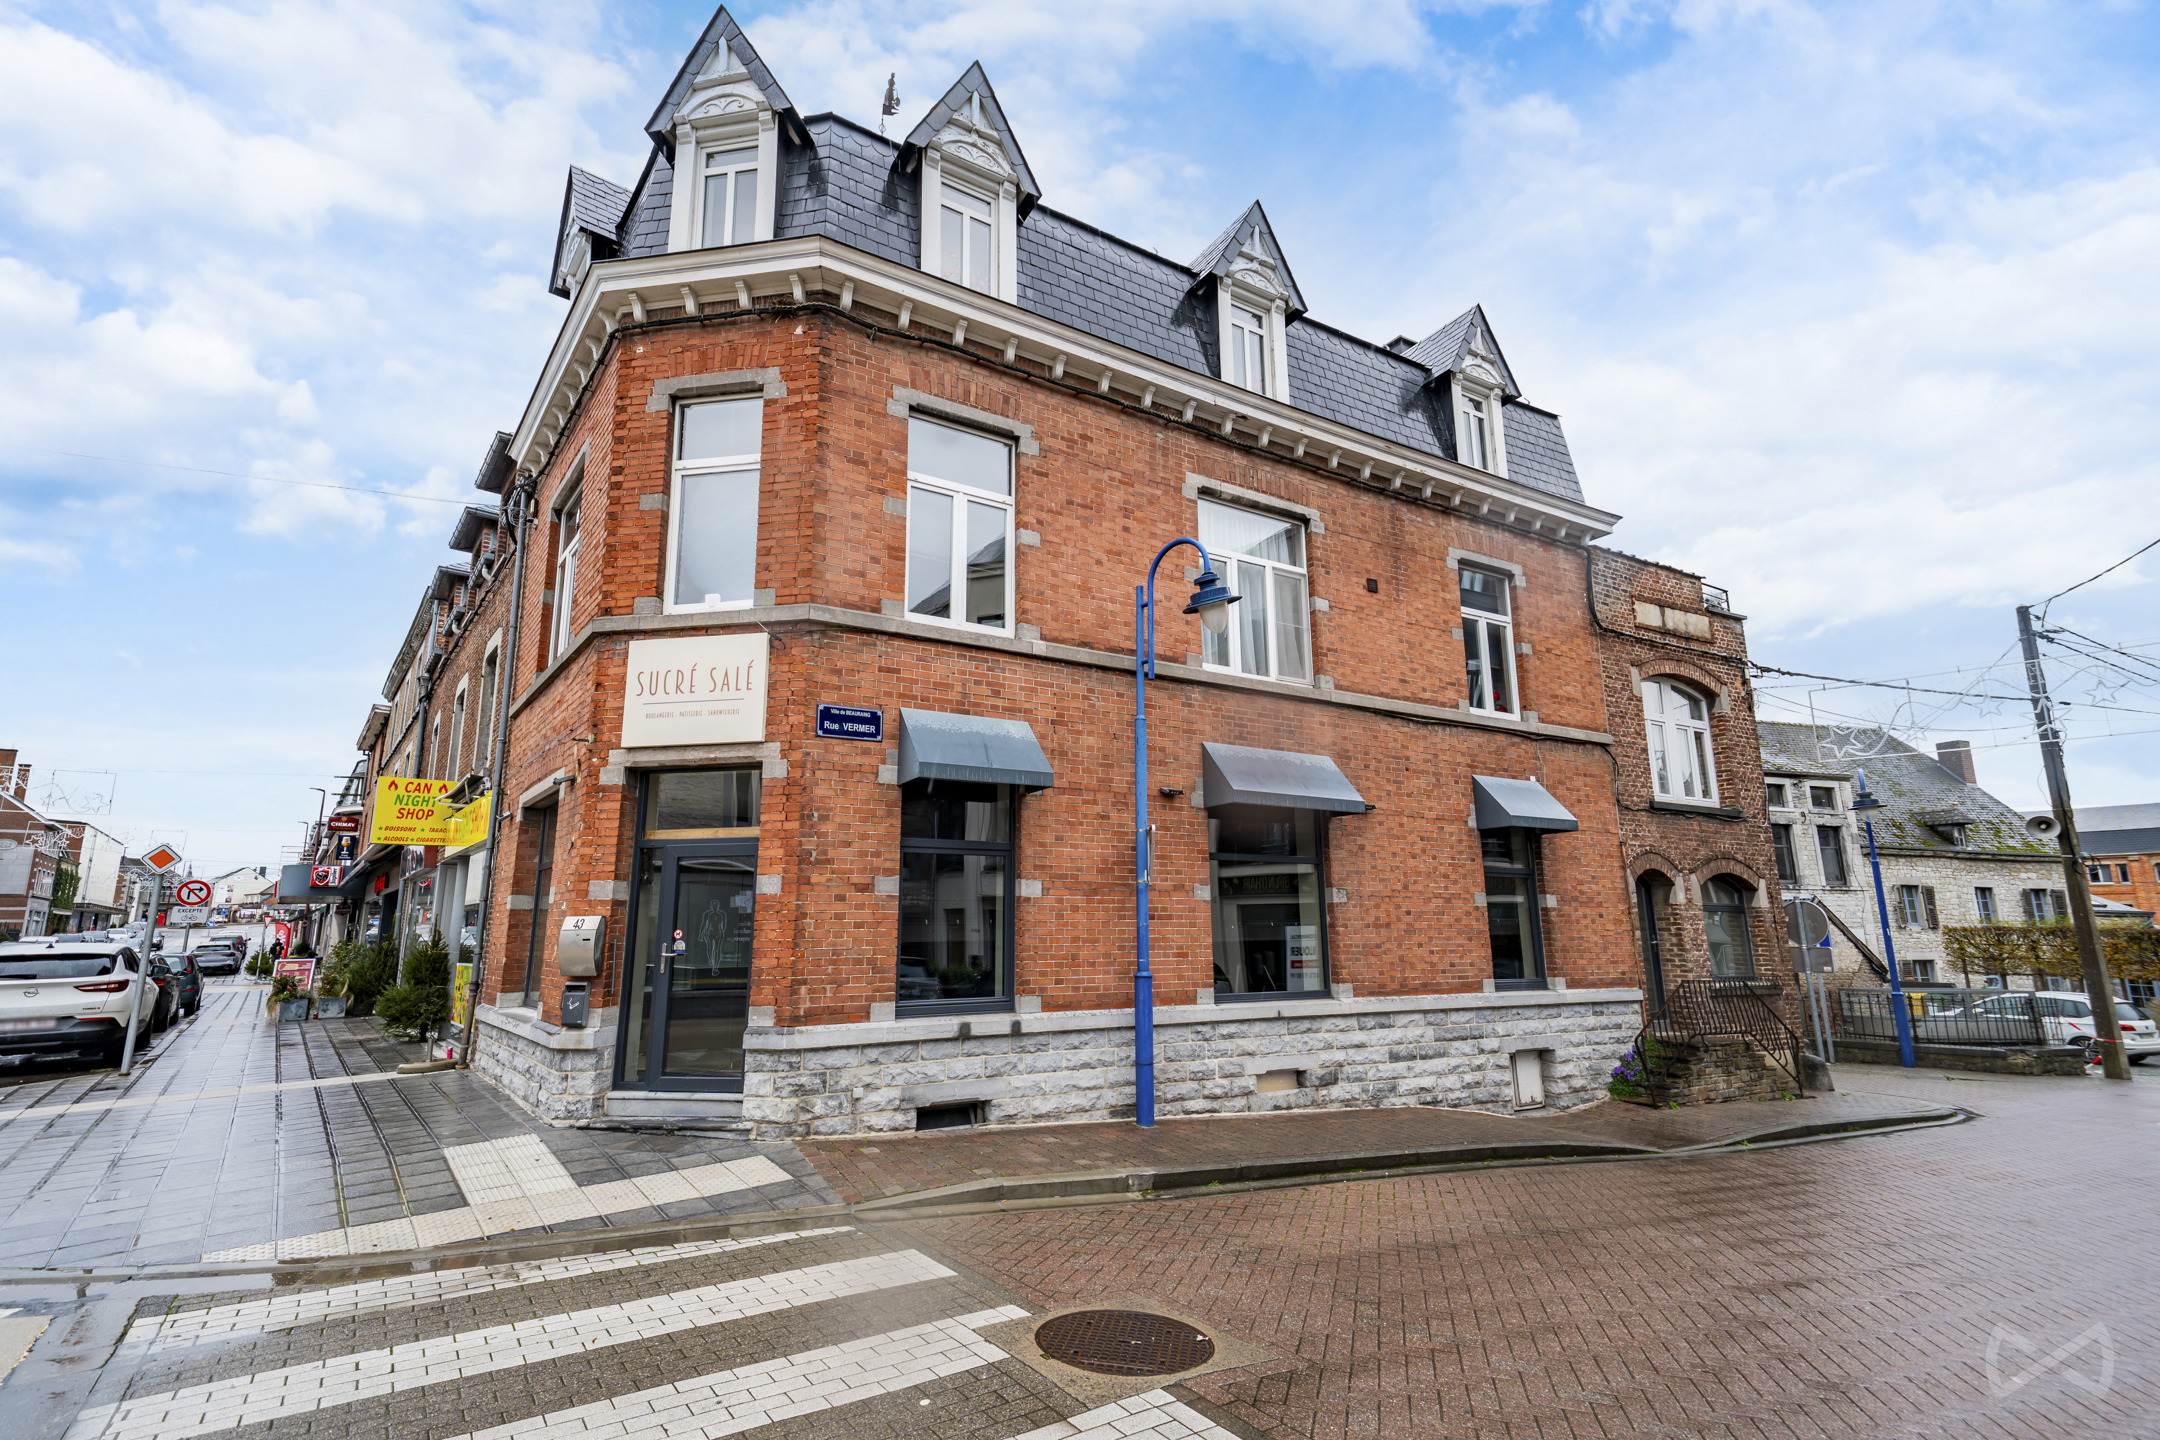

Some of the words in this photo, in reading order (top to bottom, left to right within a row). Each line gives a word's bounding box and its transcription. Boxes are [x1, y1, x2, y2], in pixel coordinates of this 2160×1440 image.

[636, 662, 698, 697] SUCRÉ
[709, 659, 755, 693] SALÉ
[645, 711, 674, 720] BOULANGERIE
[707, 708, 740, 717] SANDWICHERIE
[824, 721, 839, 730] Rue
[843, 722, 876, 733] VERMER
[405, 781, 433, 794] CAN
[394, 794, 438, 808] NIGHT
[396, 807, 435, 821] SHOP
[384, 825, 417, 833] BOISSONS
[573, 918, 585, 929] 43
